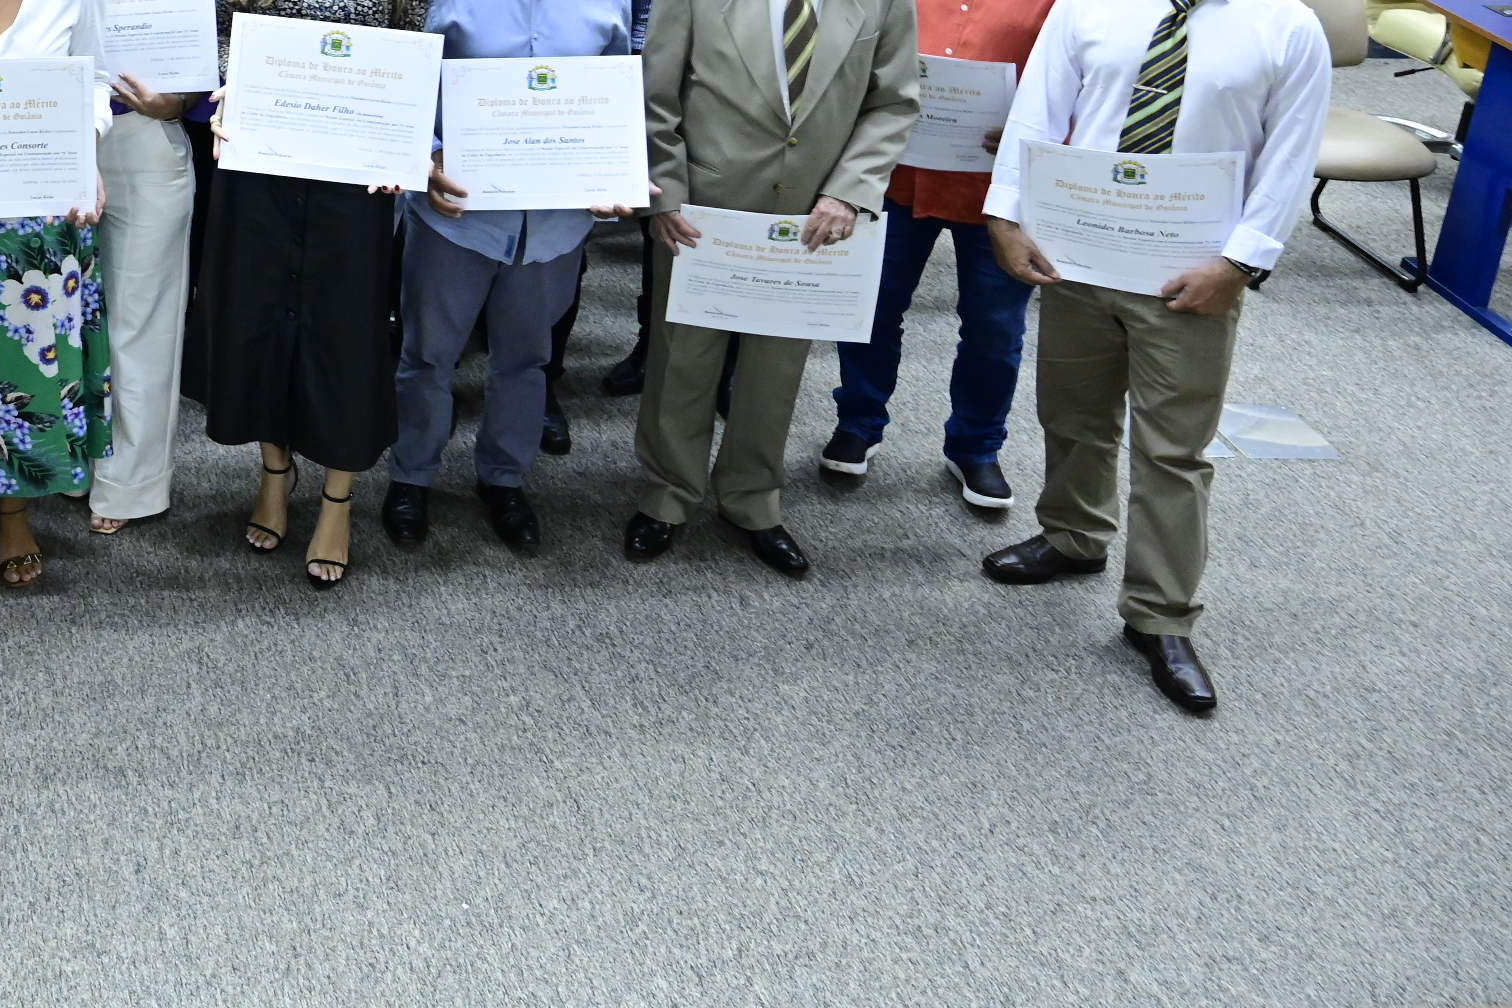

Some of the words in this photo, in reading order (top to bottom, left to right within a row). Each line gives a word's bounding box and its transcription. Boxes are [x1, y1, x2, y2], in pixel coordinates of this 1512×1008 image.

[9, 101, 21, 109] ao
[23, 98, 59, 110] Mérito
[304, 102, 330, 112] Daher
[332, 105, 355, 116] Filho
[10, 140, 49, 151] Consorte
[1117, 224, 1155, 237] Barbosa
[1159, 229, 1180, 238] Neto
